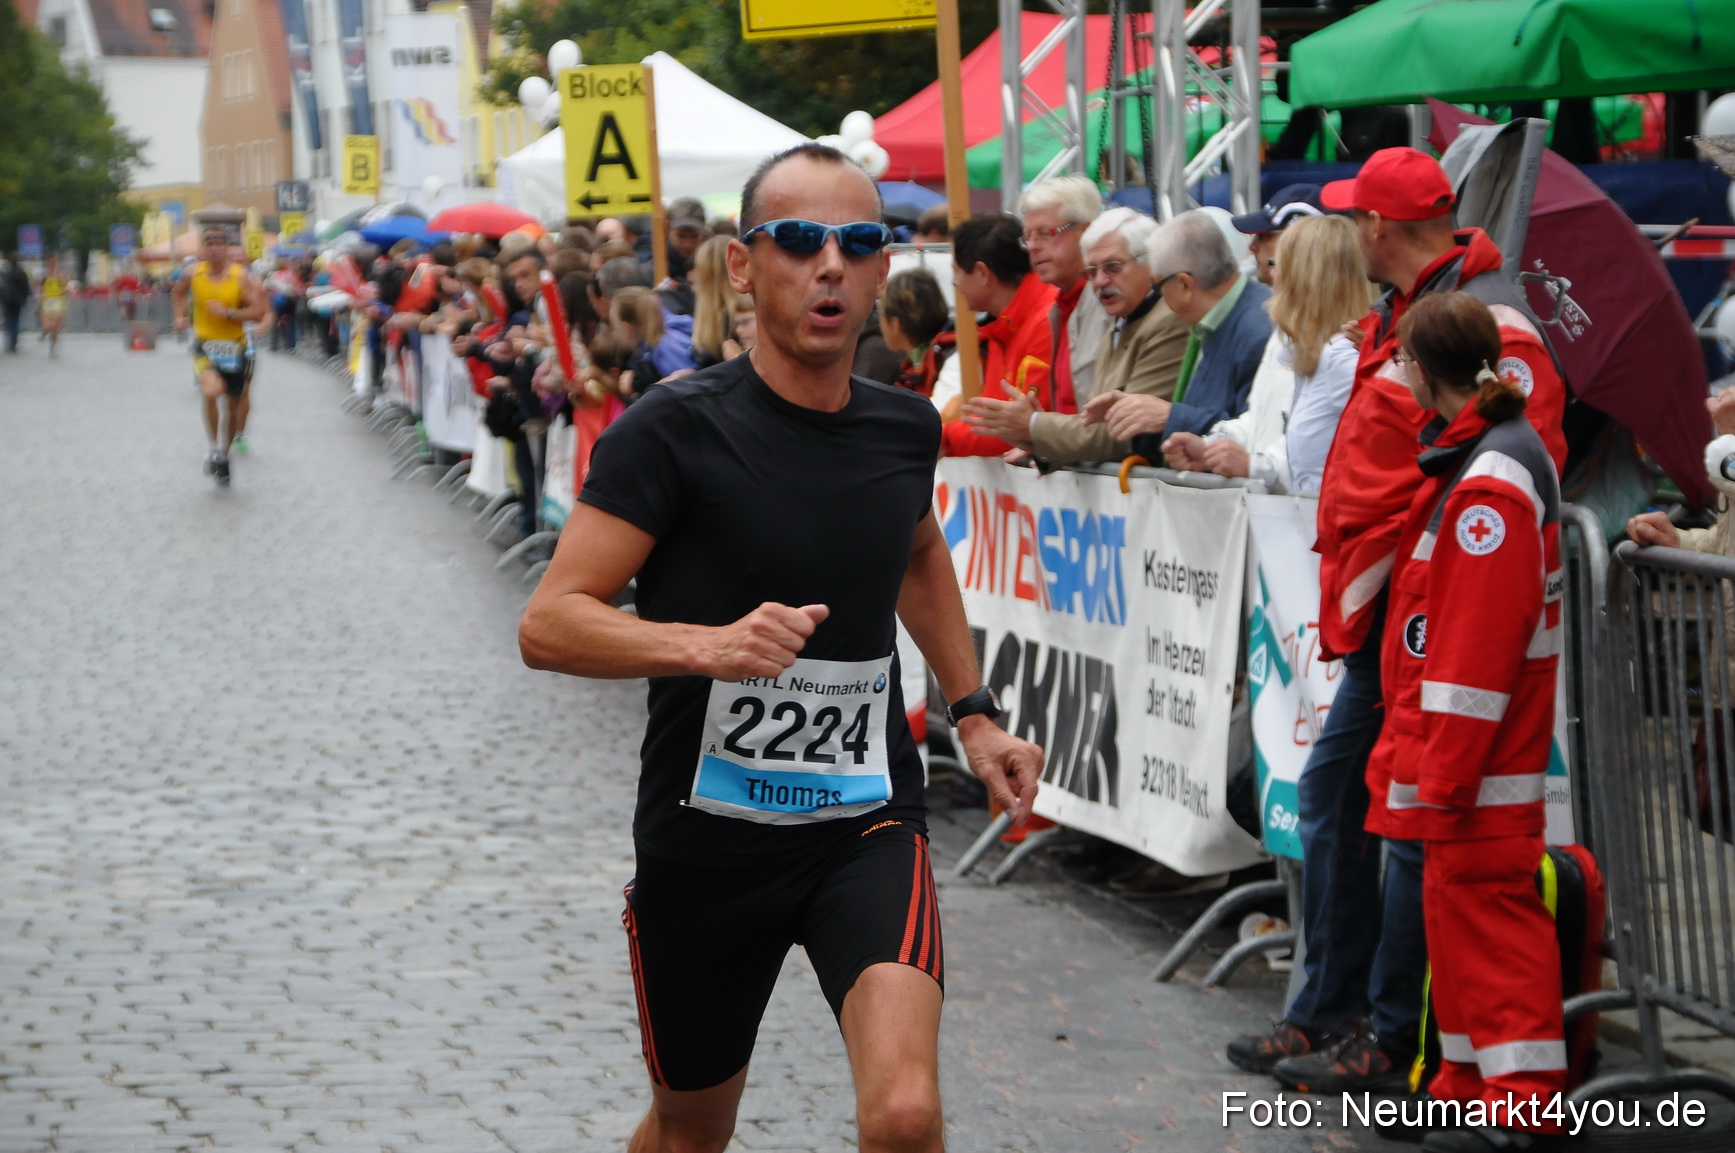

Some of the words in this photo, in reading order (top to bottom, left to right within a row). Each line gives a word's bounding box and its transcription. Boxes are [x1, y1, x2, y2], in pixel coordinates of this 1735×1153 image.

[569, 71, 646, 98] Block
[585, 110, 639, 182] A
[352, 153, 369, 180] B
[1462, 508, 1501, 528] DEUTSCHES
[965, 485, 1127, 626] INTERSPORT
[1460, 529, 1476, 550] ROTES
[1478, 533, 1501, 552] KREUZ
[1165, 630, 1207, 678] Herzen
[789, 676, 869, 696] Neumarkt
[1146, 678, 1167, 718] der
[723, 696, 871, 764] 2224
[709, 744, 717, 754] A
[745, 777, 844, 807] Thomas
[1141, 753, 1177, 803] 92318
